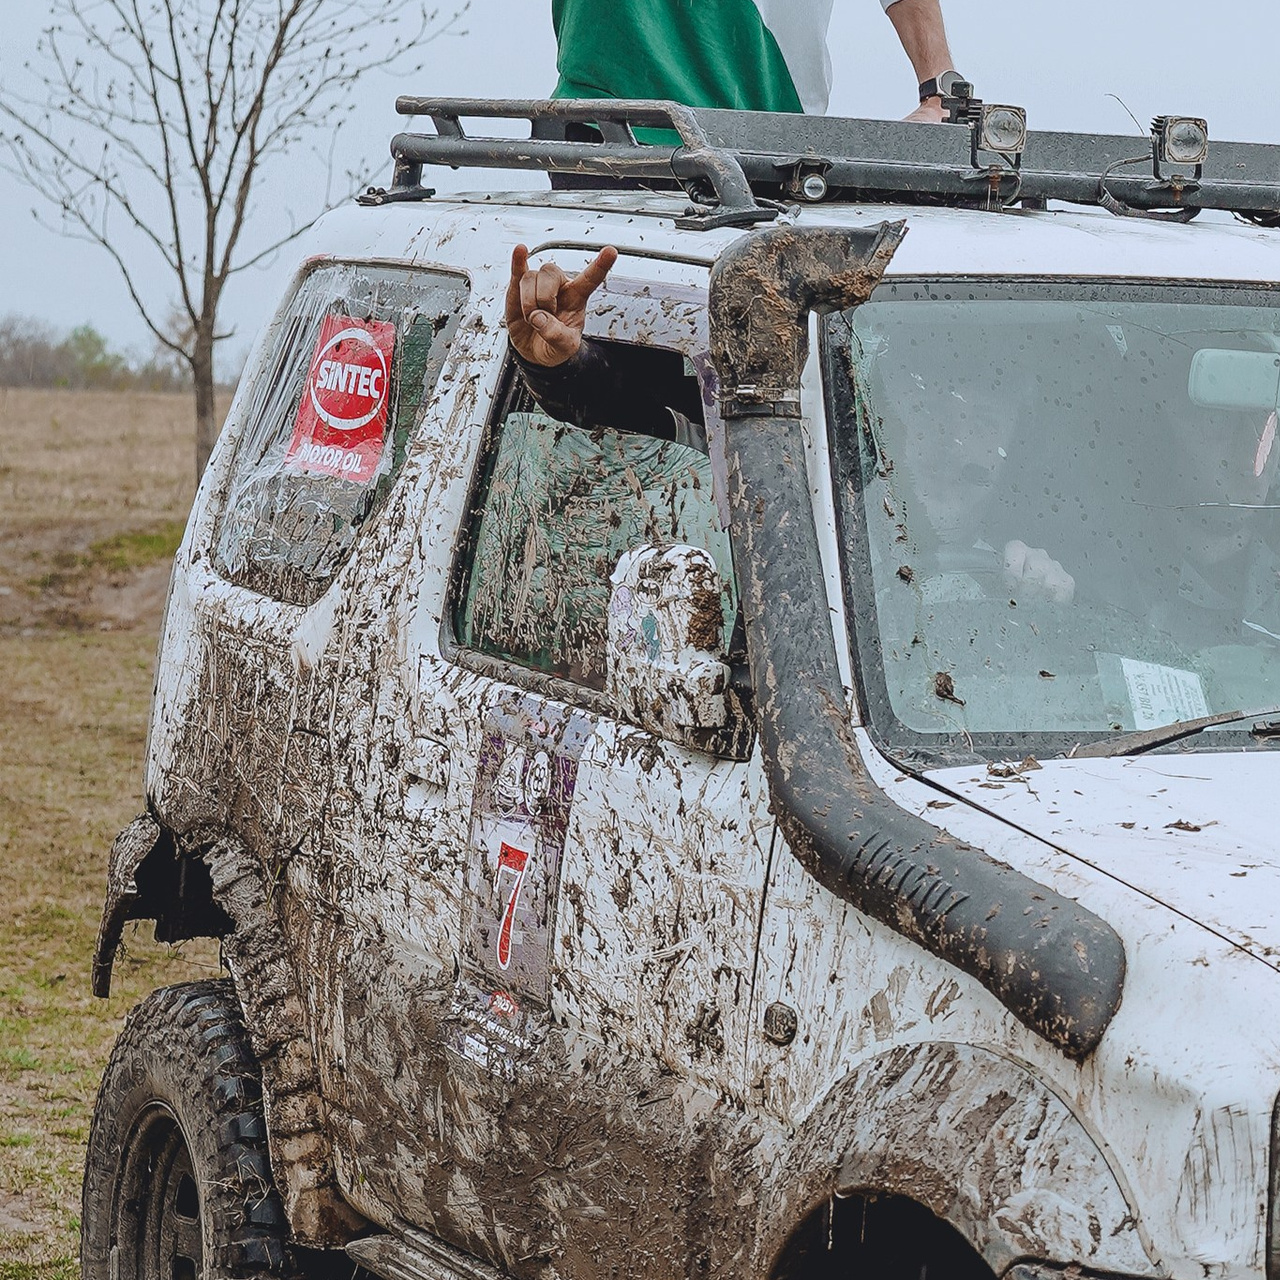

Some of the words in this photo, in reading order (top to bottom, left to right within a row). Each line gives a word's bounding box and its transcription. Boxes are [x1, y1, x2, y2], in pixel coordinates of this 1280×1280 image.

[315, 359, 382, 399] SINTEC
[299, 442, 343, 469] MOTOR
[342, 451, 363, 474] OIL
[494, 838, 530, 971] 7
